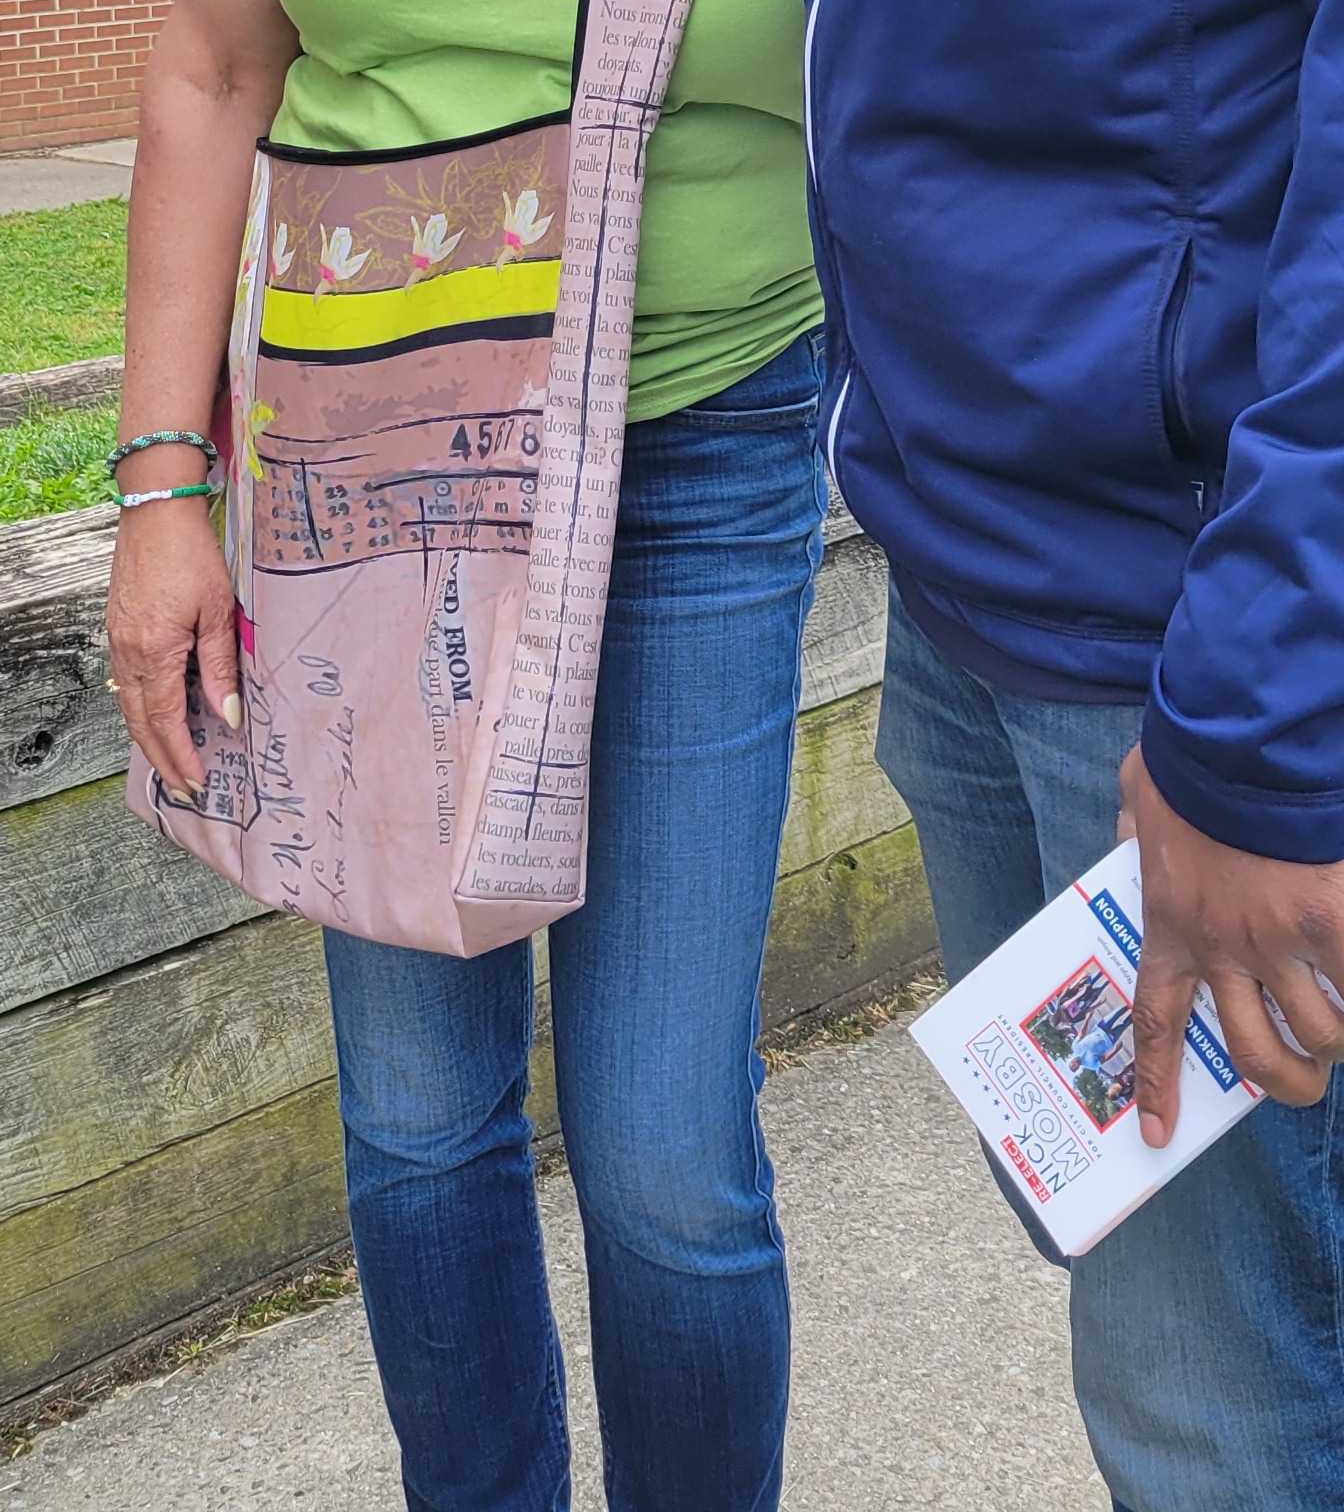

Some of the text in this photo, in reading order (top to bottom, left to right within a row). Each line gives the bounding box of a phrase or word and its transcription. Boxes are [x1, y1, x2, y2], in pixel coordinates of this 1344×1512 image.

[600, 0, 637, 22] Nous
[602, 25, 619, 46] les
[578, 102, 593, 120] de
[575, 131, 630, 150] jouer la
[574, 153, 602, 176] paille
[570, 178, 599, 199] Nous
[569, 206, 585, 224] les
[604, 292, 619, 308] tu
[597, 314, 609, 334] la
[546, 388, 564, 408] les
[586, 479, 605, 493] un
[596, 504, 609, 520] tu
[577, 524, 590, 545] la
[524, 600, 541, 621] les
[444, 626, 473, 702] FROM
[512, 684, 577, 708] te tu
[431, 704, 451, 753] dans
[501, 706, 540, 730] jouer
[555, 714, 566, 735] la
[504, 737, 574, 764] paille près
[435, 759, 454, 777] le
[556, 772, 583, 793] près
[436, 783, 457, 845] vallon
[550, 797, 579, 816] dans
[476, 814, 525, 844] champ
[477, 843, 497, 865] les
[501, 848, 554, 871] rochers,
[471, 870, 490, 891] les
[494, 875, 548, 897] arcades,
[997, 1013, 1103, 1159] FOR CITY COUNCIL PRESIDENT
[973, 1034, 1091, 1183] MOSBY
[1005, 1137, 1050, 1201] RE-ELECT
[1014, 1124, 1066, 1195] NICK
